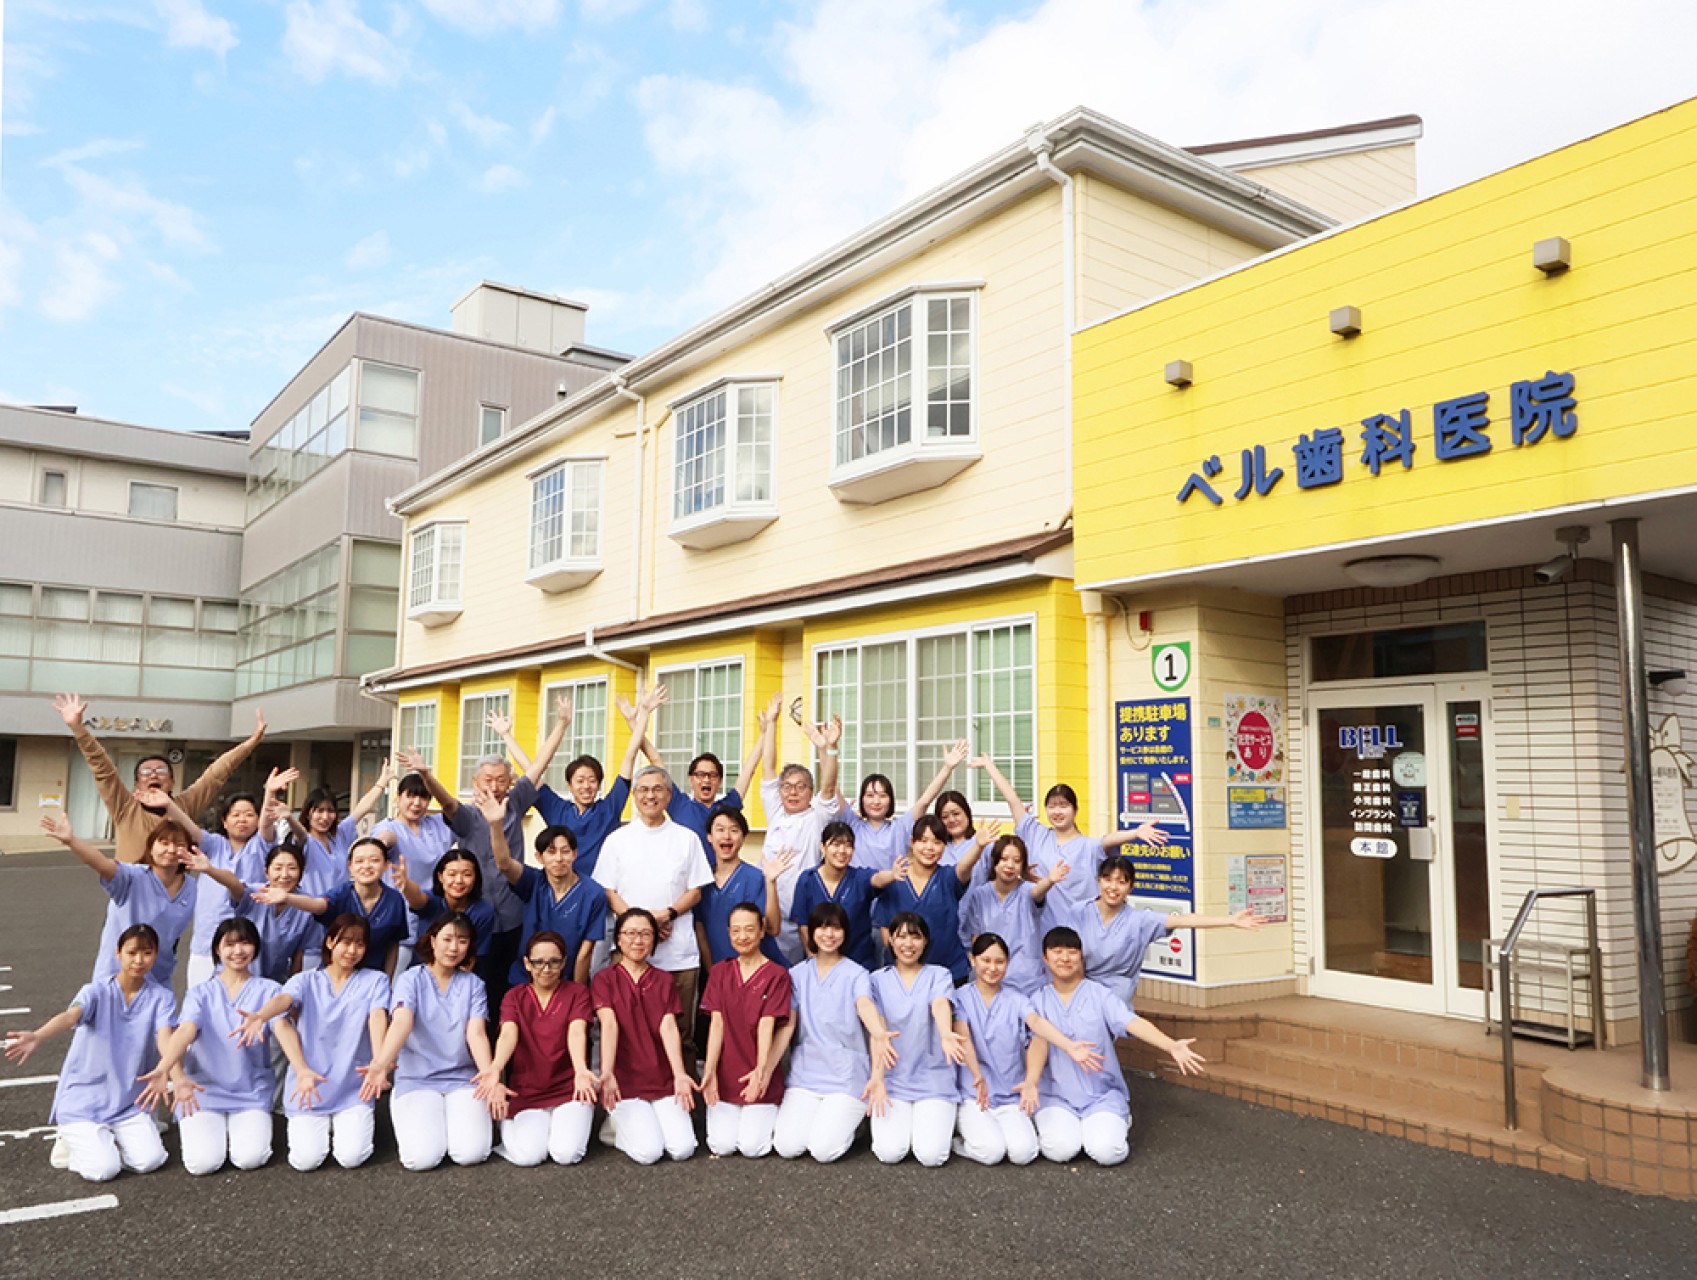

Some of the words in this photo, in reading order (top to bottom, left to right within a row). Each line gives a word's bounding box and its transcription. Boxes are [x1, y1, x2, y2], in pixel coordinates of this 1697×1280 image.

[1177, 370, 1578, 505] ベル歯科医院
[1163, 652, 1178, 683] 1
[1119, 703, 1187, 724] 提携駐車場
[1119, 725, 1171, 743] あります
[1339, 725, 1403, 757] BELL
[1352, 768, 1391, 780] 一般歯科
[1353, 795, 1392, 806] 小児歯科
[1349, 809, 1396, 819] インプラント
